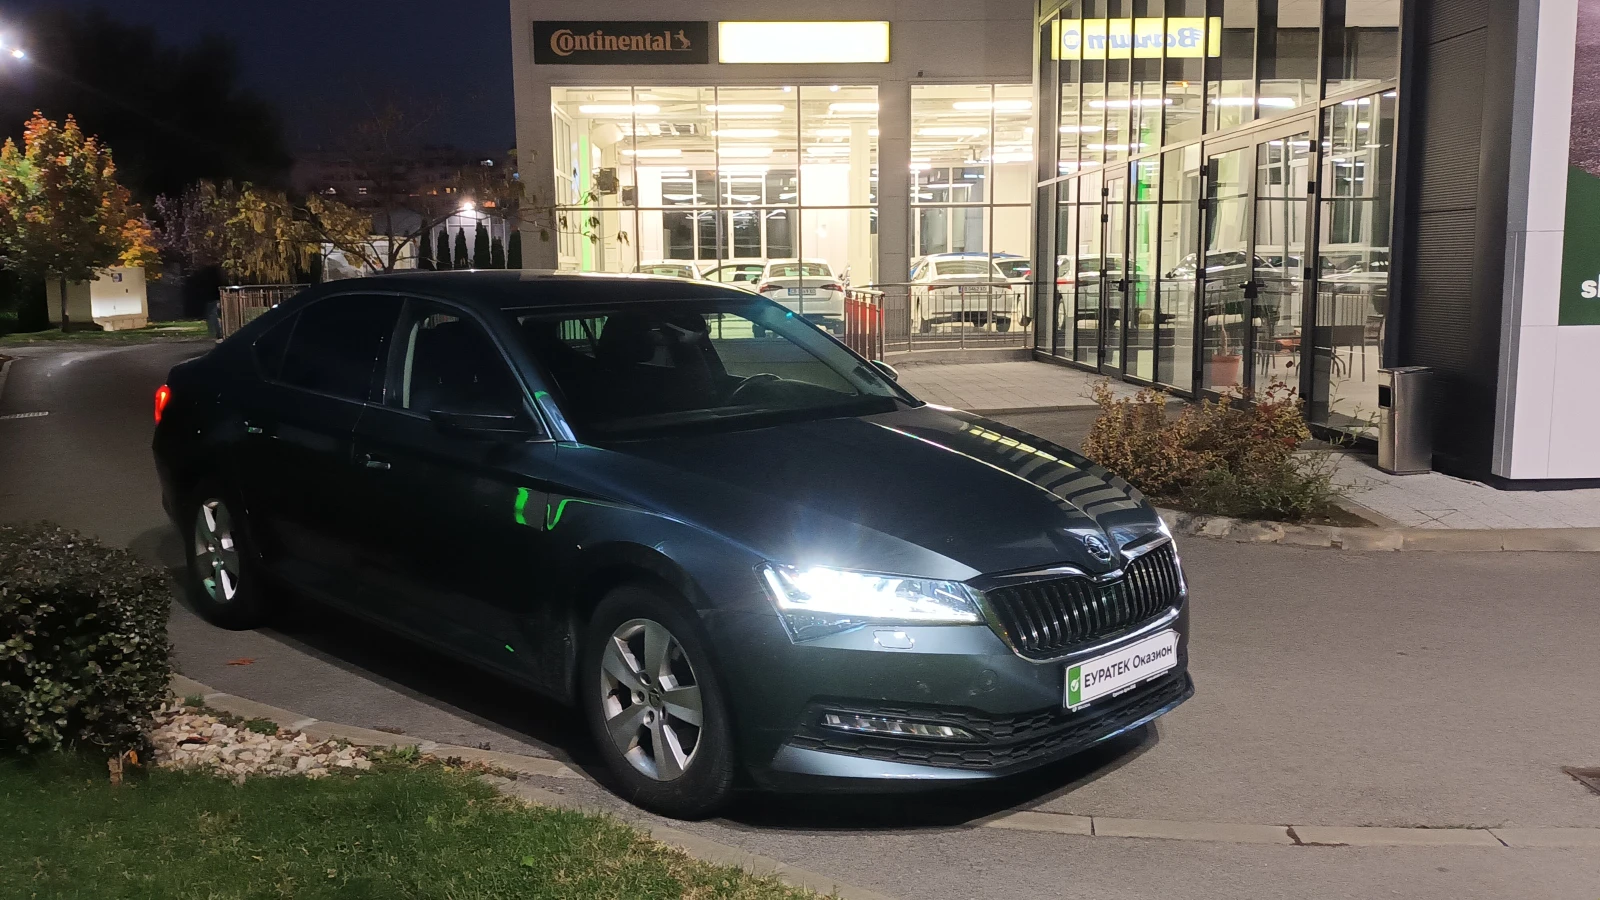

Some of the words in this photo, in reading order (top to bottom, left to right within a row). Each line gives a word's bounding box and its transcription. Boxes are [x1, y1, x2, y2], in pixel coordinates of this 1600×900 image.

[550, 28, 672, 57] Continental
[1580, 273, 1600, 299] s
[1084, 658, 1131, 688] ЕУРАТЕК
[1132, 645, 1173, 669] Оказион
